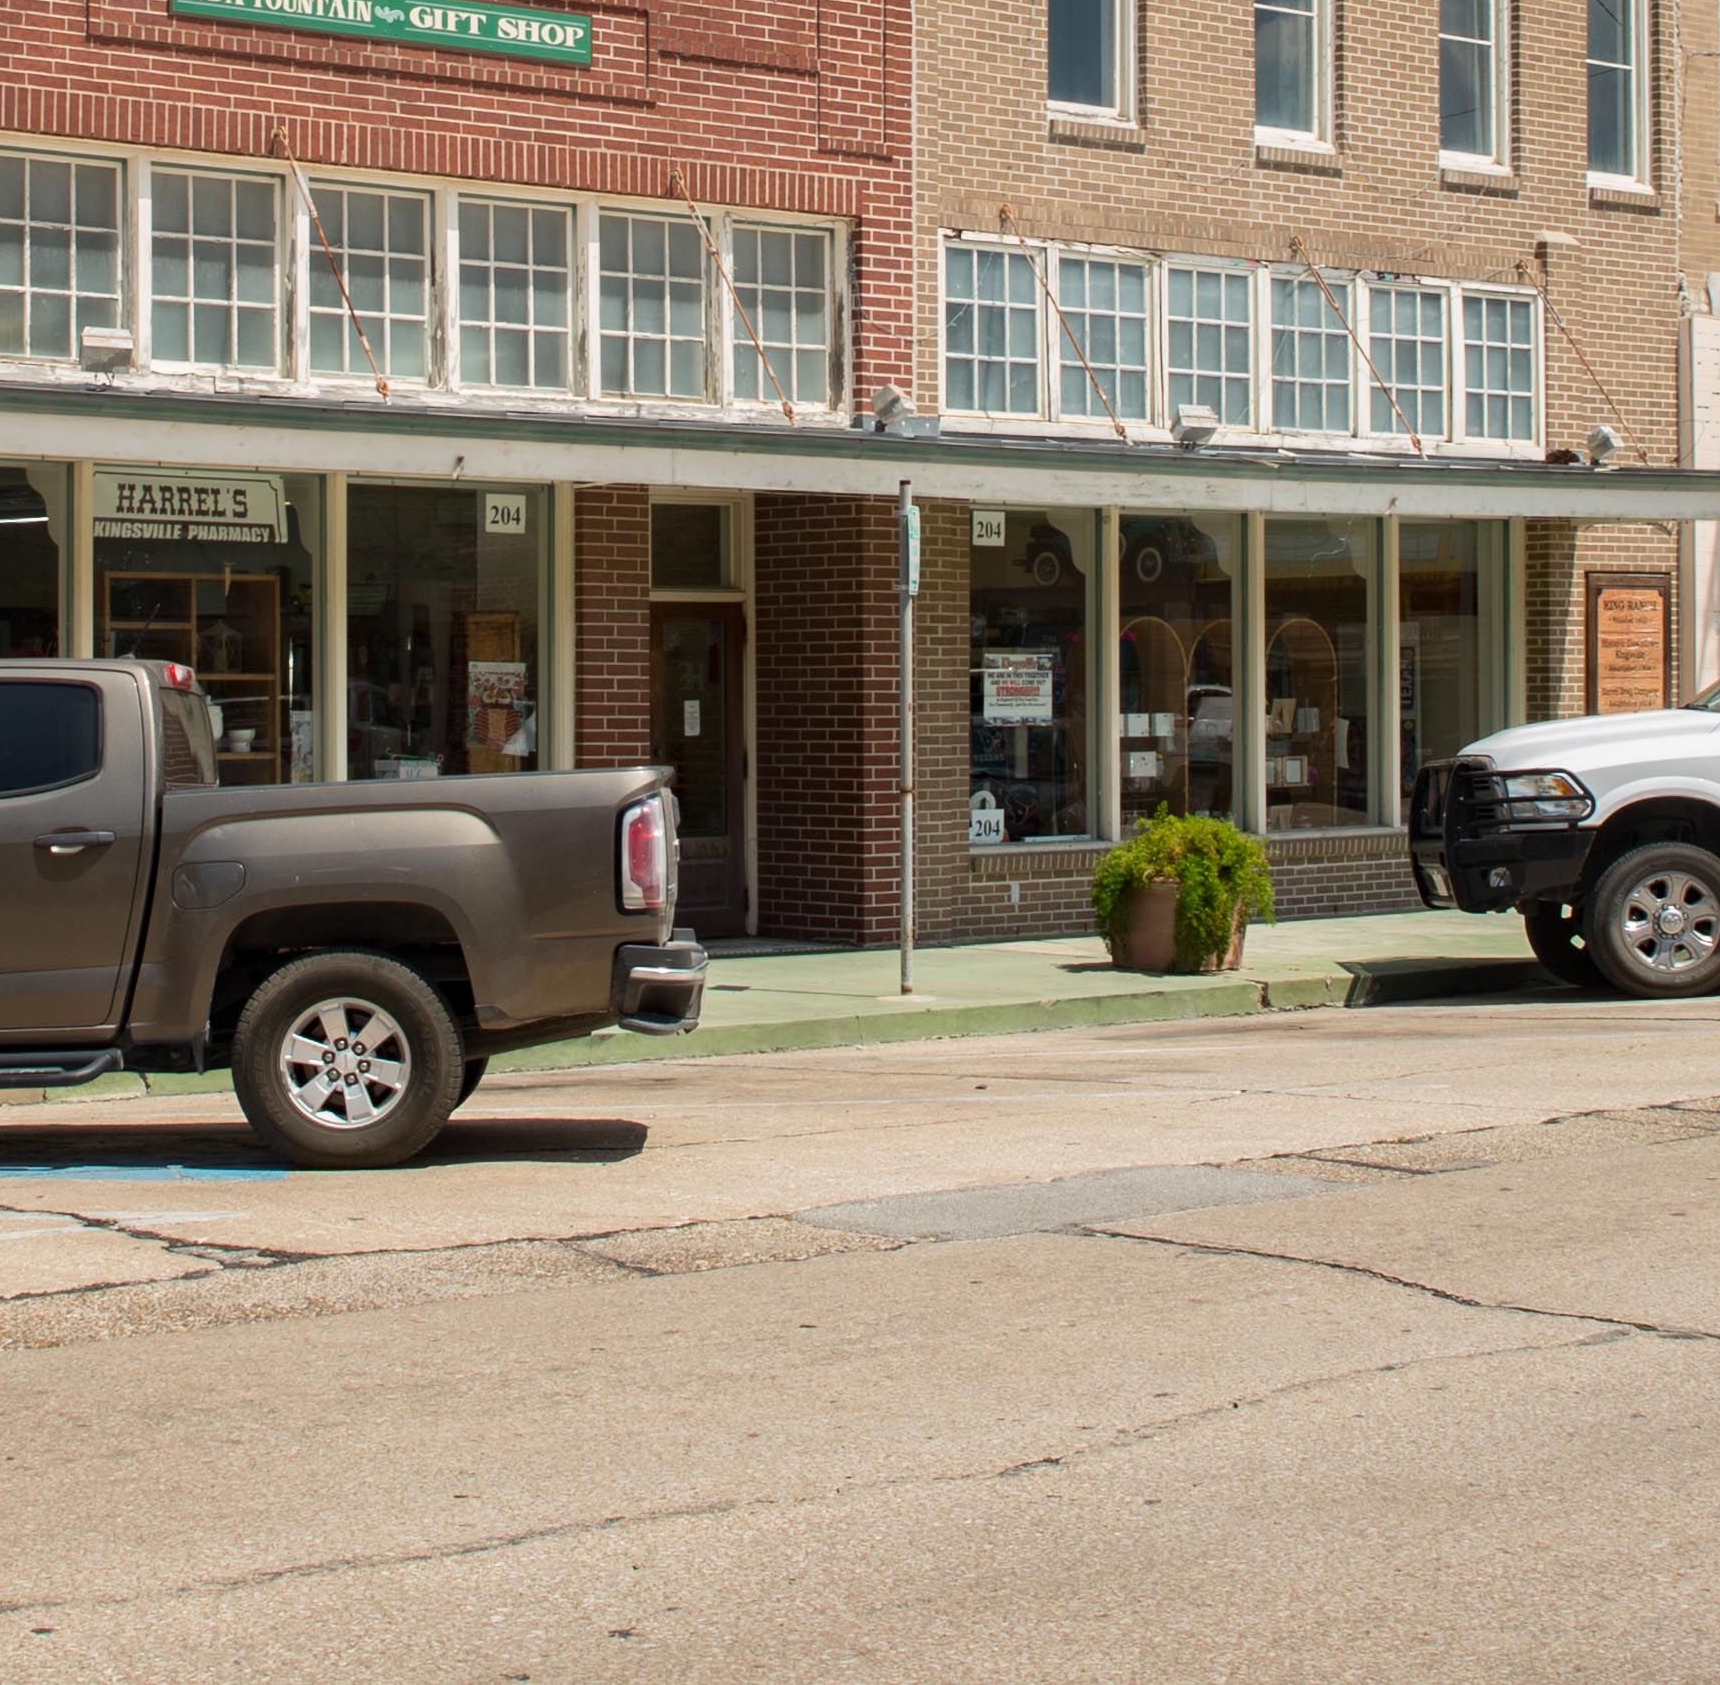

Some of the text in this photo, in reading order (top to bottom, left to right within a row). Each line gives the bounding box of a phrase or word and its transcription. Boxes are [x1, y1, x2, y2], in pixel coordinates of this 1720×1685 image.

[409, 6, 486, 35] GIFT
[497, 18, 584, 47] SHOP
[116, 483, 248, 518] HARREL'S
[490, 505, 521, 525] 204
[94, 521, 271, 542] KINGSVILLE PHARMACY
[976, 521, 1001, 538] 204
[1603, 600, 1625, 611] KING
[975, 819, 1001, 837] 204
